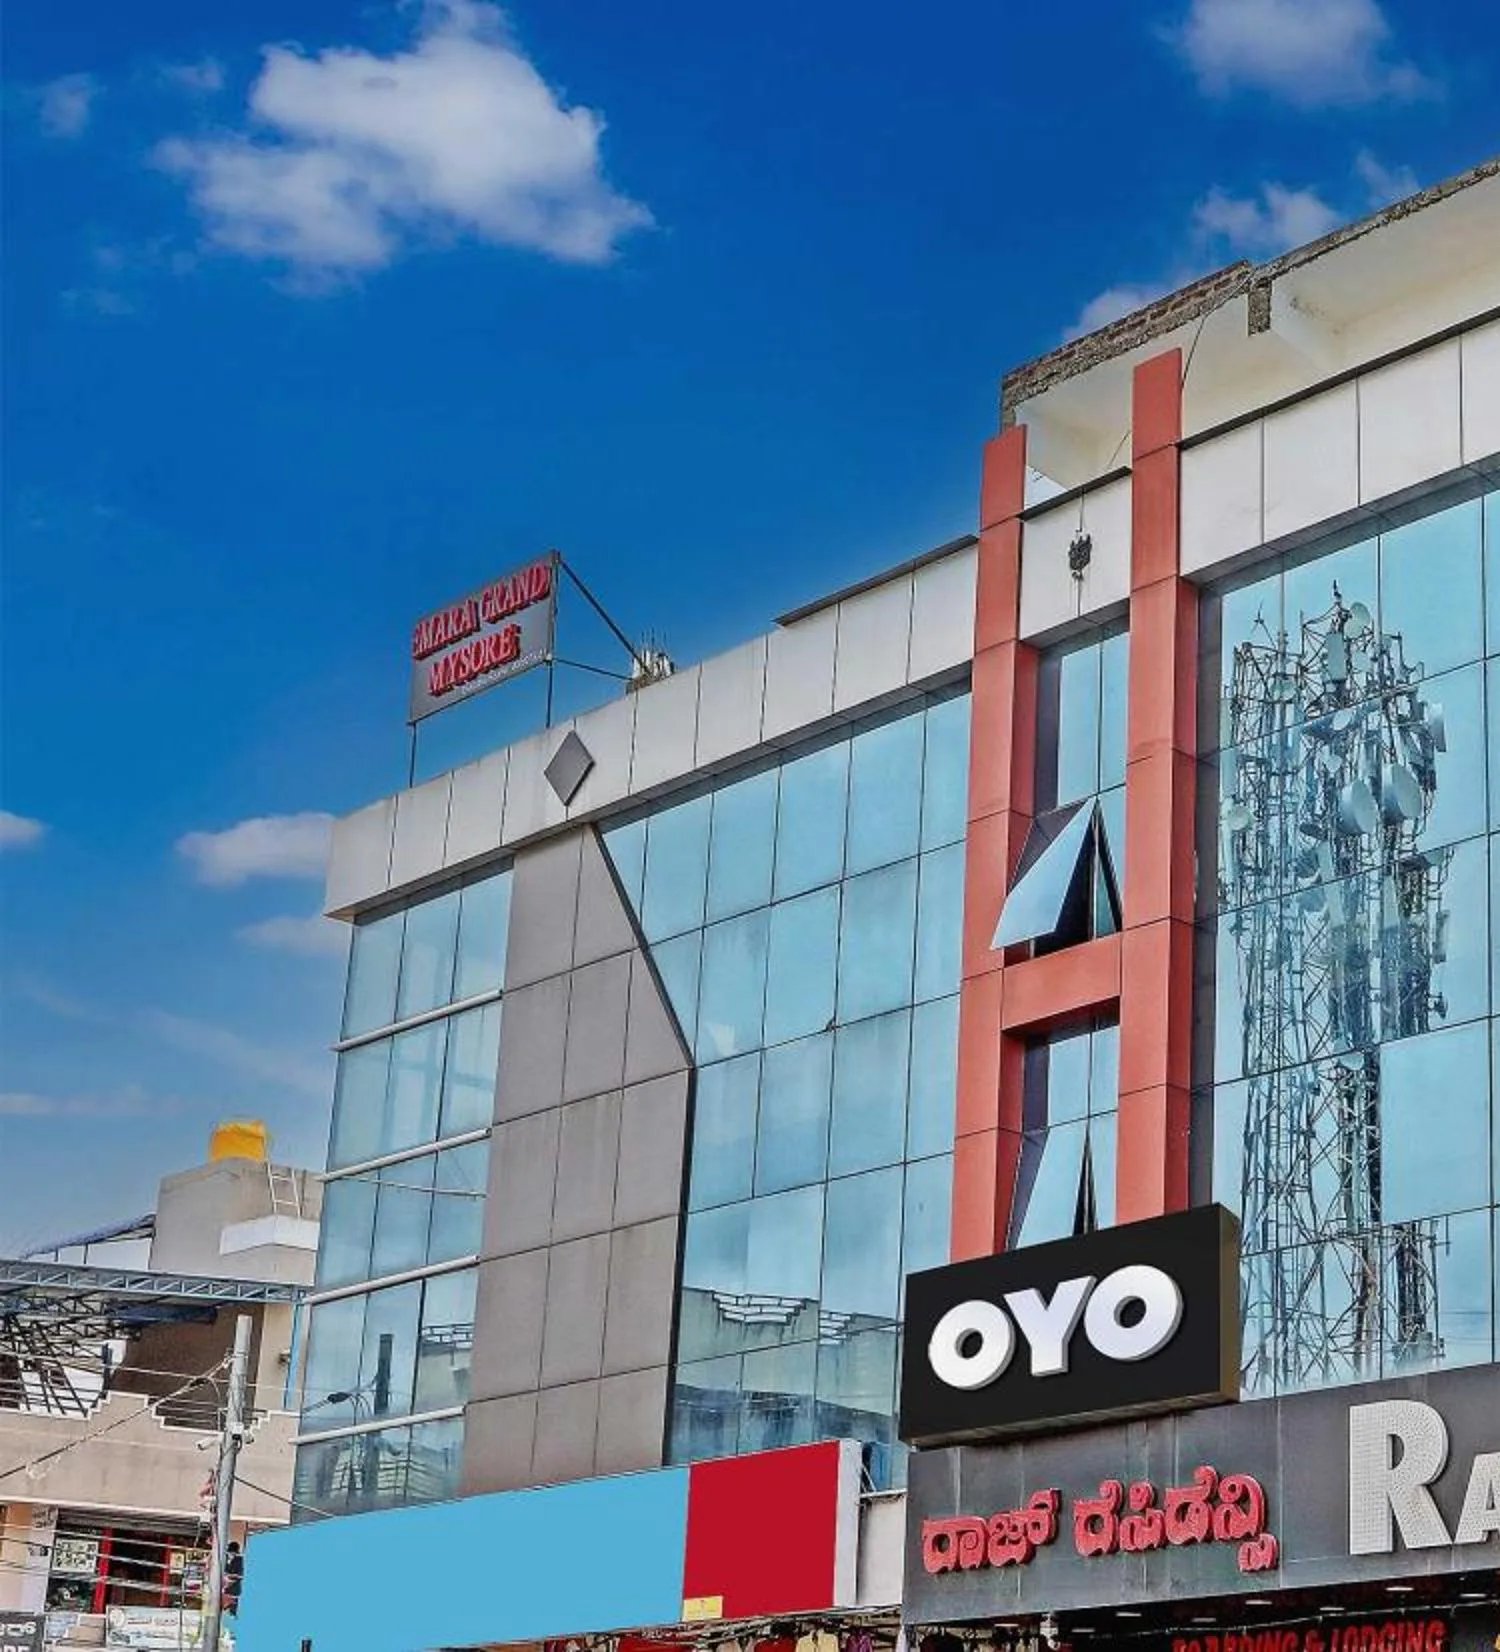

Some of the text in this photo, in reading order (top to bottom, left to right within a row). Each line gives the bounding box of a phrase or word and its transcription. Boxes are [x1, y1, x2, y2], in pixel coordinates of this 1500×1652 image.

[481, 562, 551, 623] GRAND
[928, 1265, 1183, 1390] OYO
[923, 1488, 1061, 1573] ರಾಜ್
